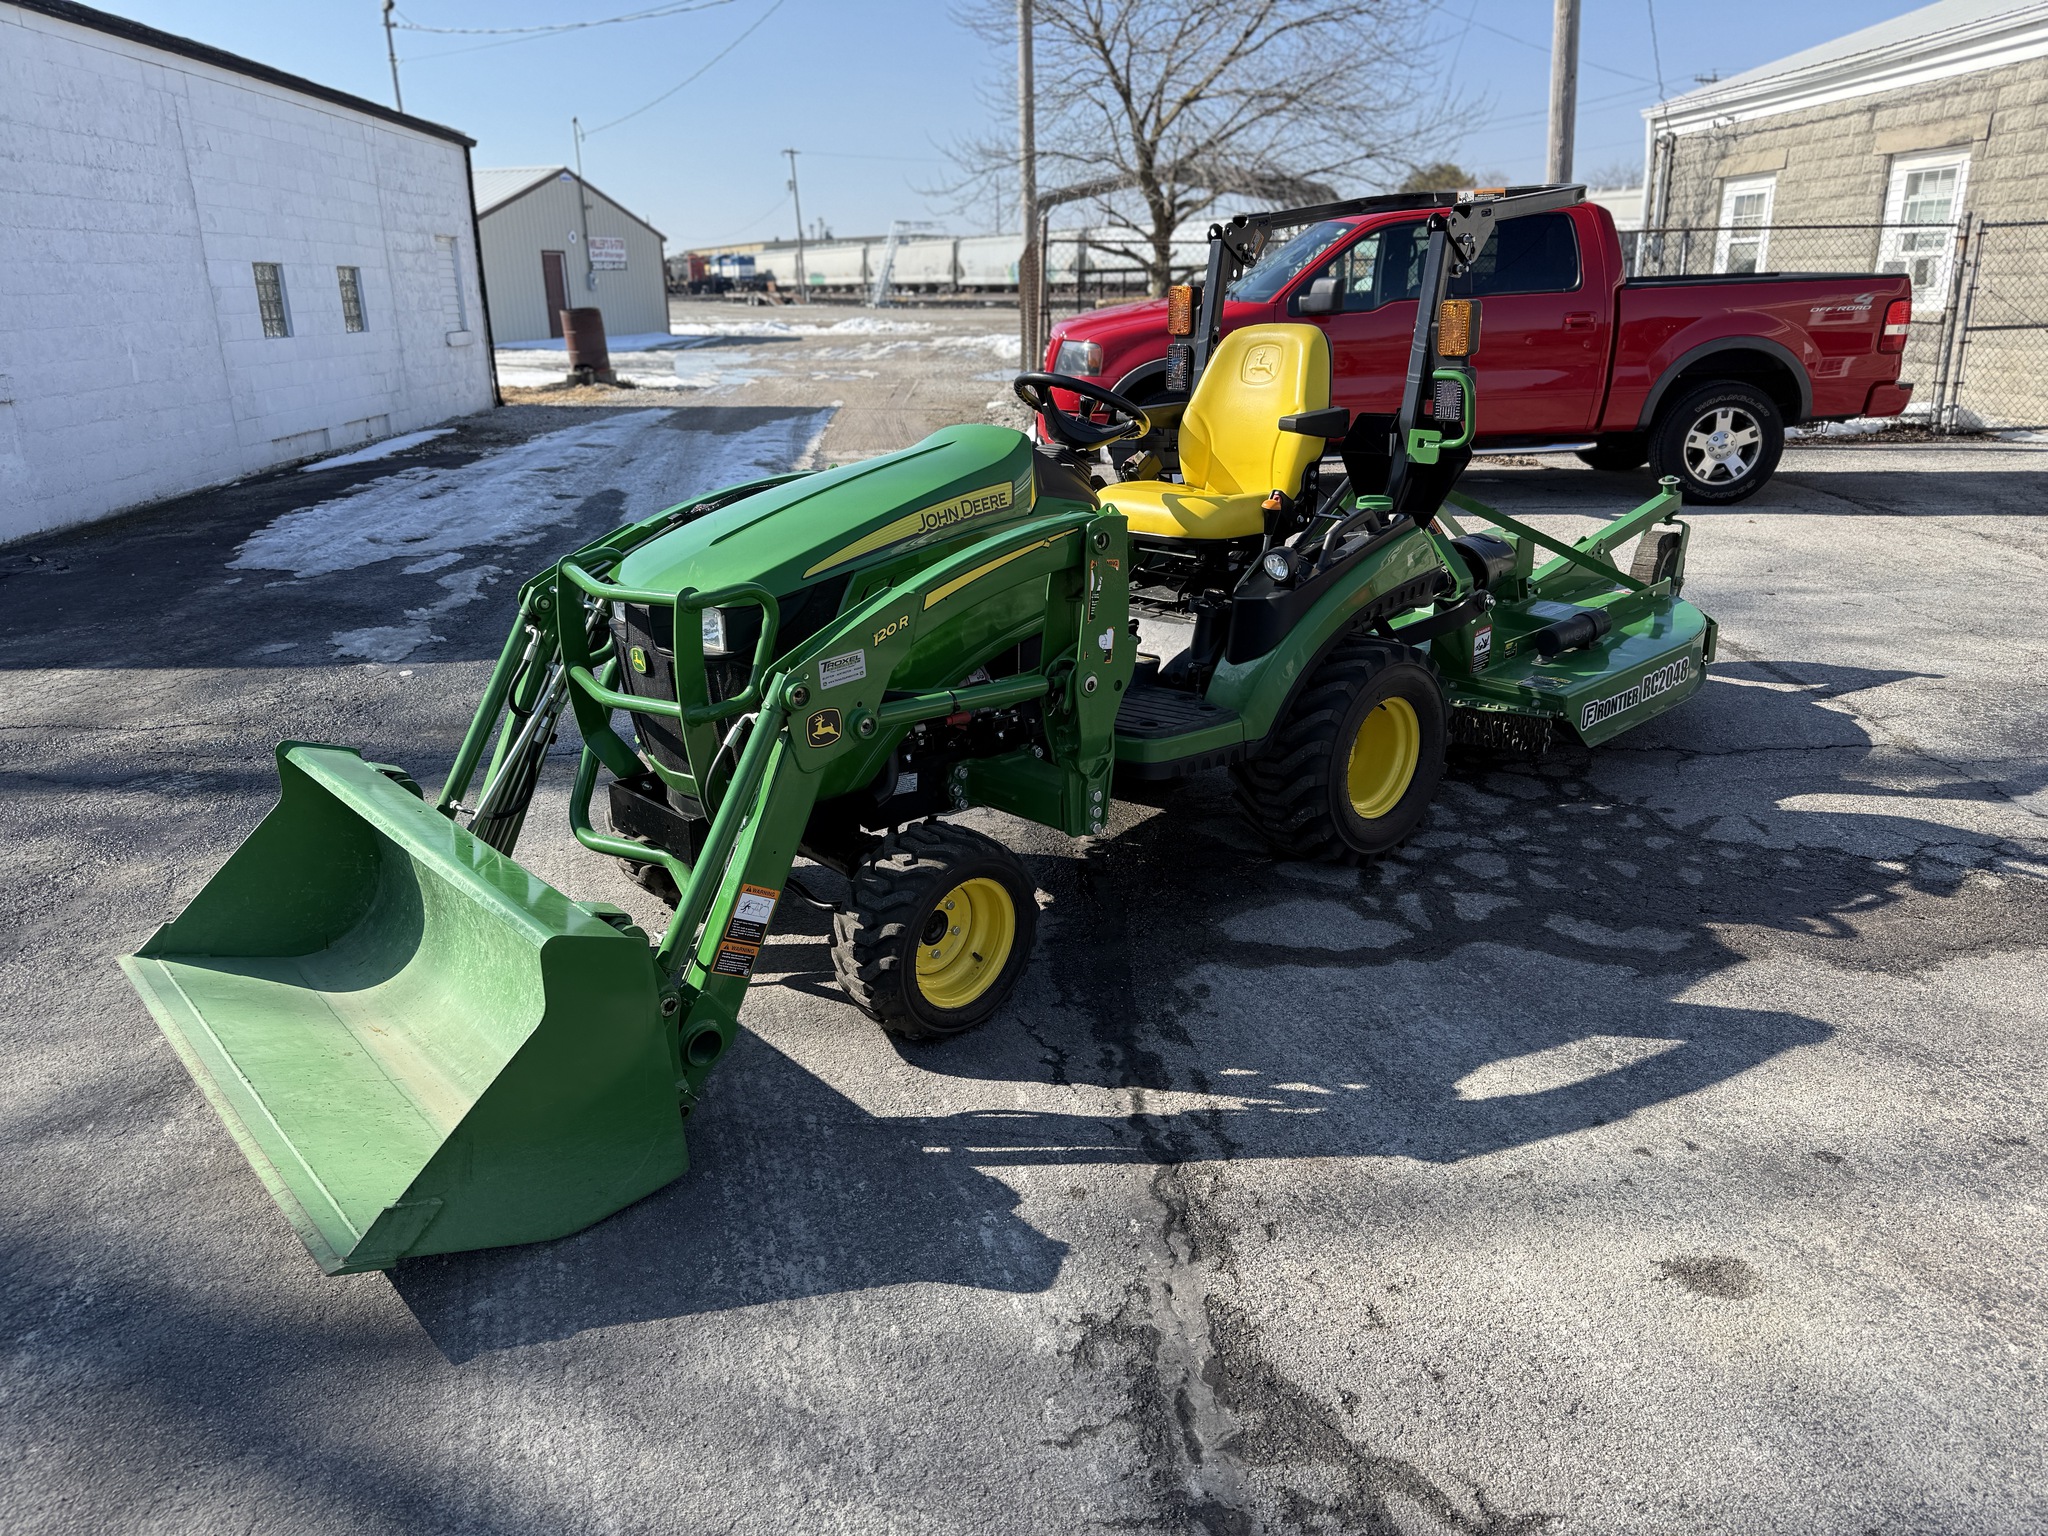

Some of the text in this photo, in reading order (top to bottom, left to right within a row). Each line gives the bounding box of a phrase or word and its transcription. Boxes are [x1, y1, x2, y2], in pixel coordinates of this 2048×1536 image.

[917, 492, 1008, 533] JOHN DEERE
[873, 615, 909, 648] 120 R
[820, 654, 861, 673] TROXEL
[1581, 656, 1690, 731] FRONTIER RC2048
[752, 888, 776, 897] WARNING
[731, 945, 755, 954] WARNING
